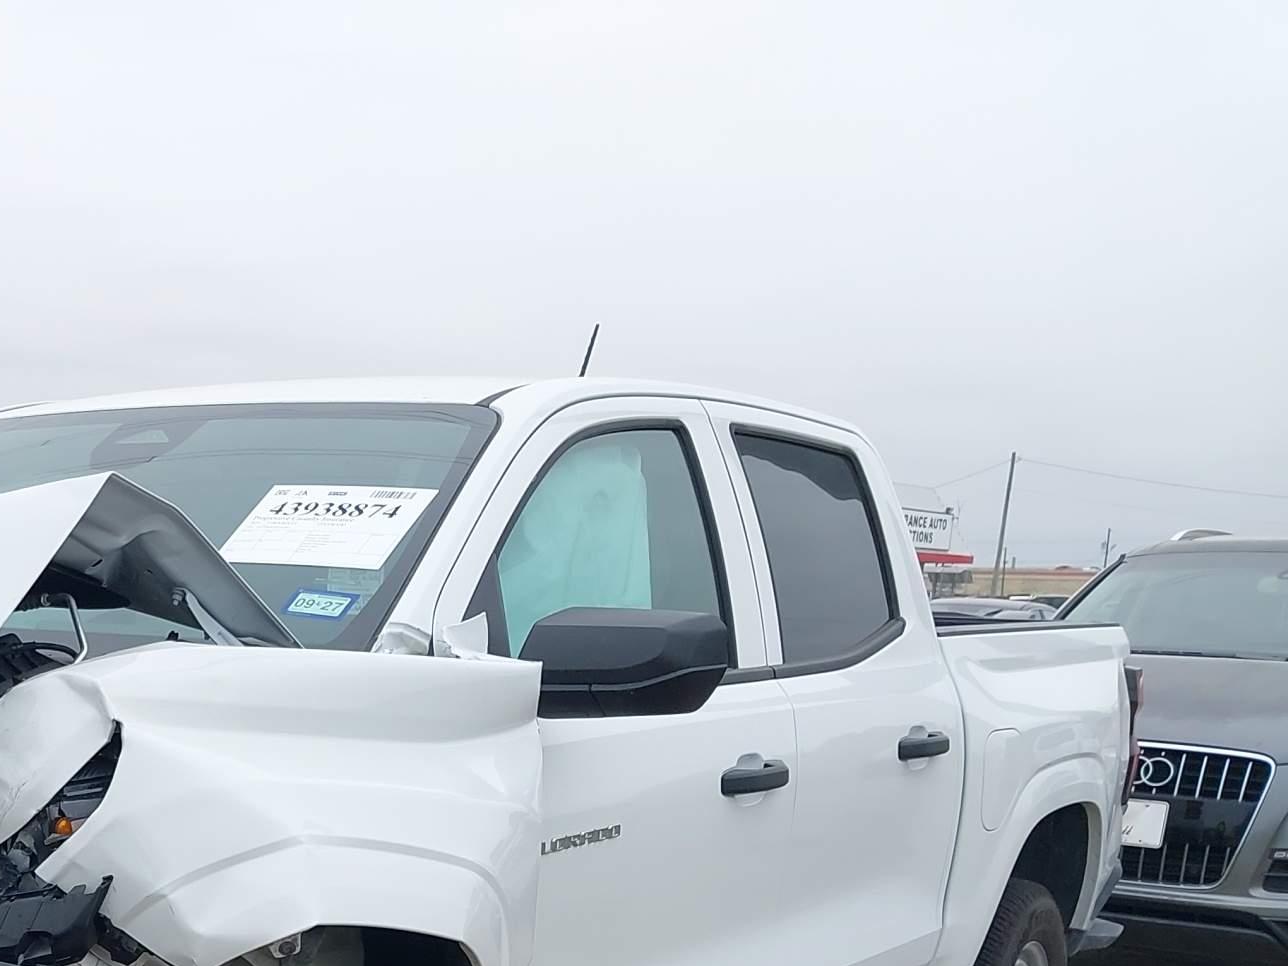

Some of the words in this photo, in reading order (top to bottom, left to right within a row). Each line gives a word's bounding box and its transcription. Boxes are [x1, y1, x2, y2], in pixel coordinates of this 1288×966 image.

[269, 501, 403, 519] 43938874
[929, 517, 947, 530] AUTO
[909, 529, 933, 544] TIONS
